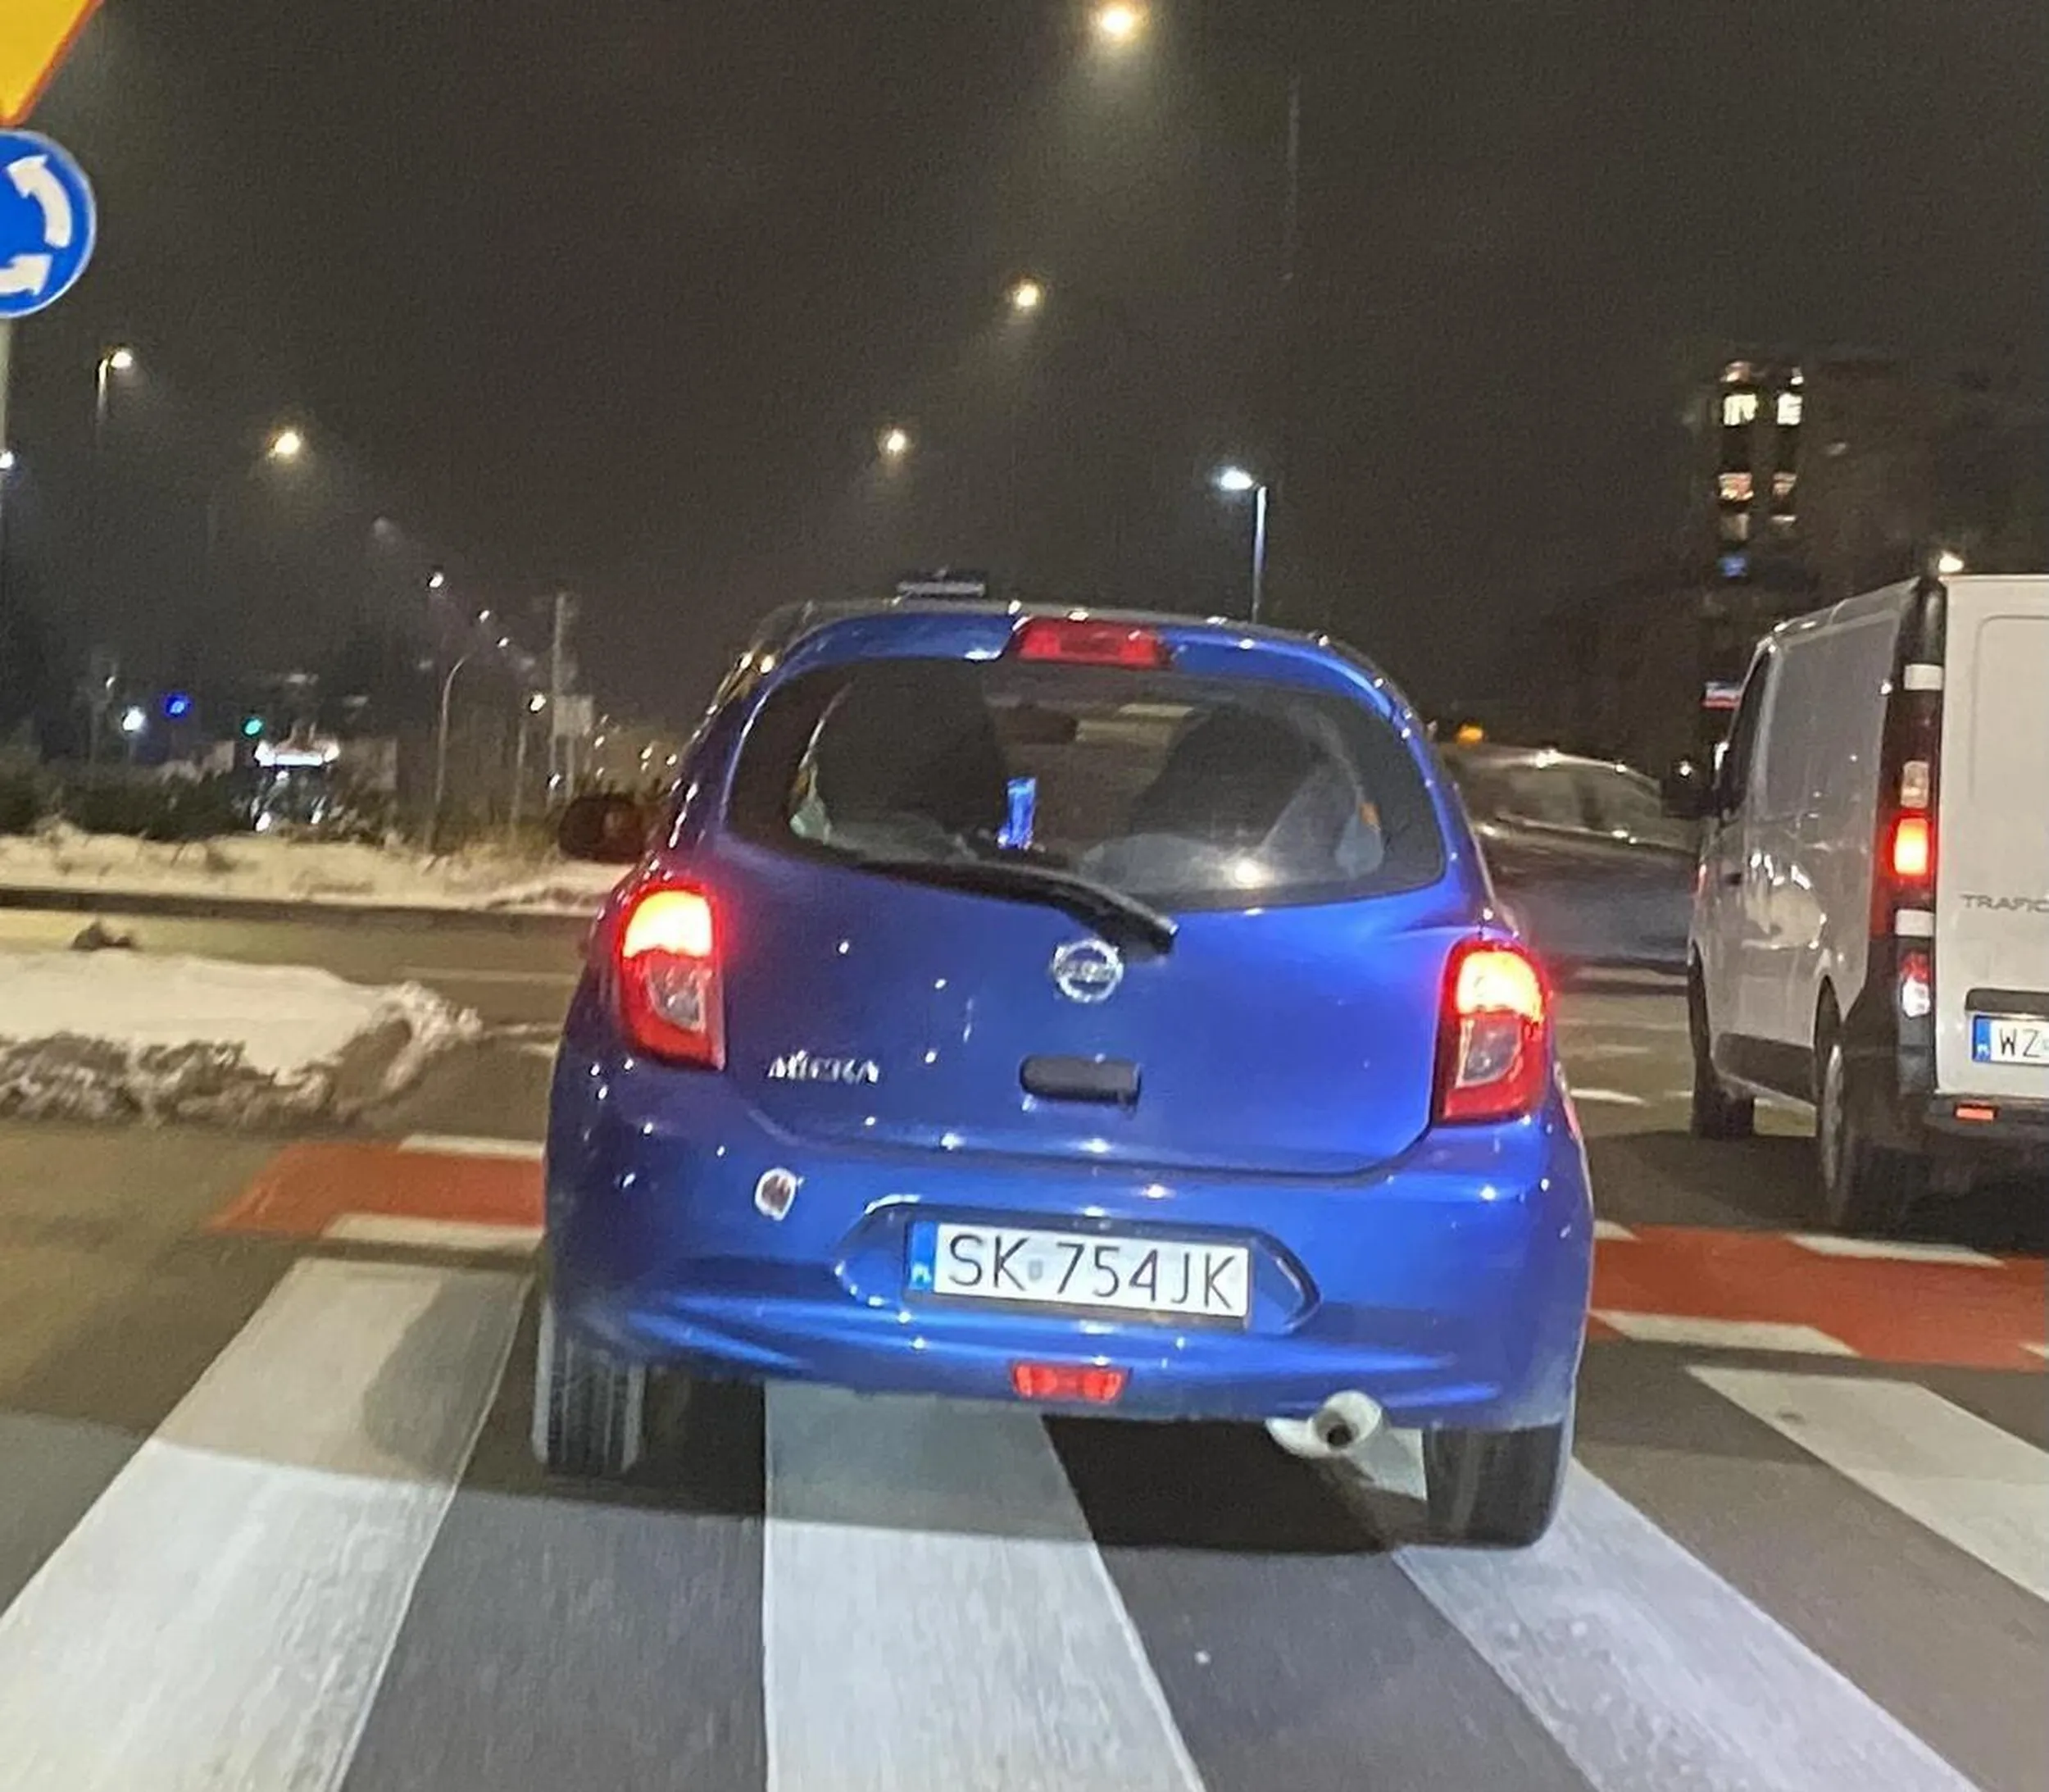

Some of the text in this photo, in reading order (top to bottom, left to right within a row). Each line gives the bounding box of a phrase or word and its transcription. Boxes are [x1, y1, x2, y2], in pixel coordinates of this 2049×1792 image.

[1999, 1027, 2041, 1057] WZ
[949, 1234, 1235, 1309] SK 754JK
